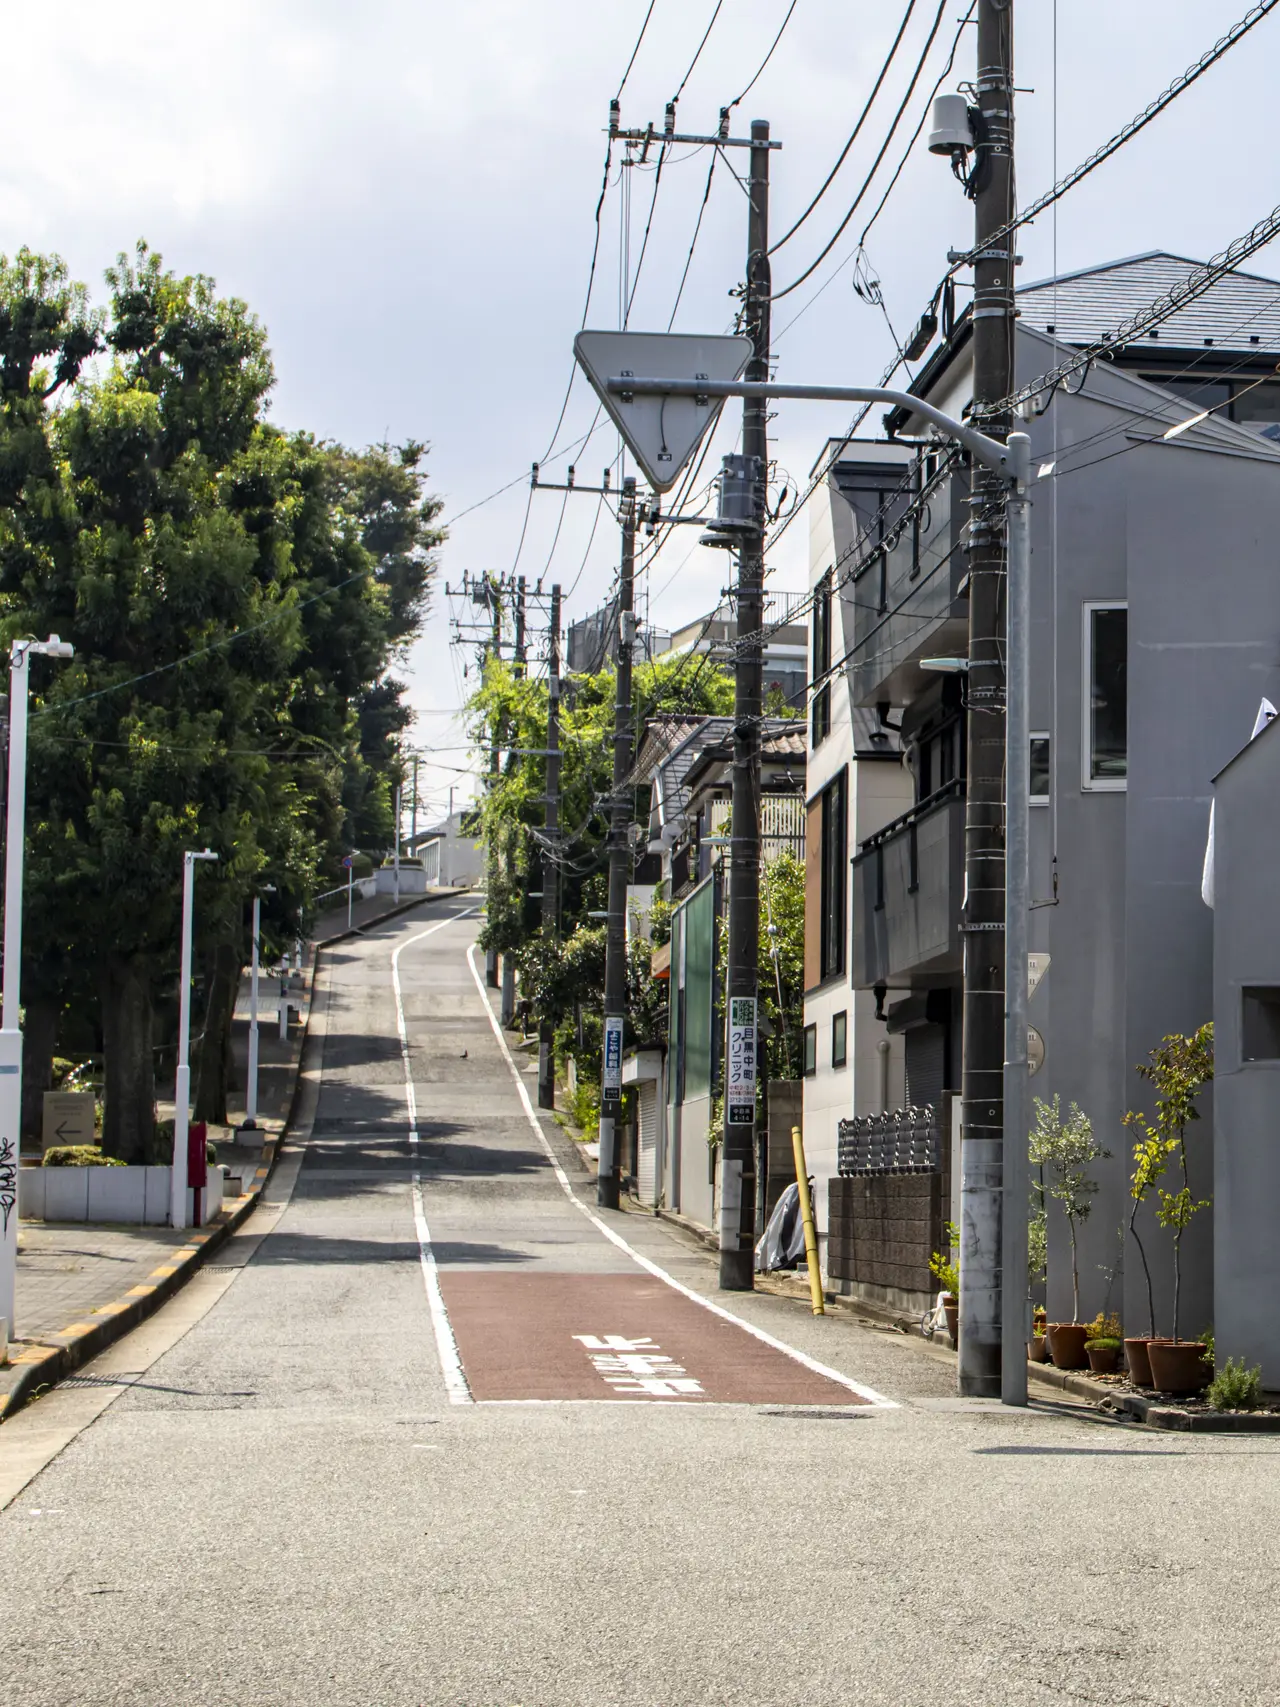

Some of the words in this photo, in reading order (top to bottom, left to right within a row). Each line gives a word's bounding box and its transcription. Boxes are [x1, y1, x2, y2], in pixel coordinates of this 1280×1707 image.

[731, 1032, 742, 1083] クリニック
[743, 1027, 754, 1081] 目黒中町
